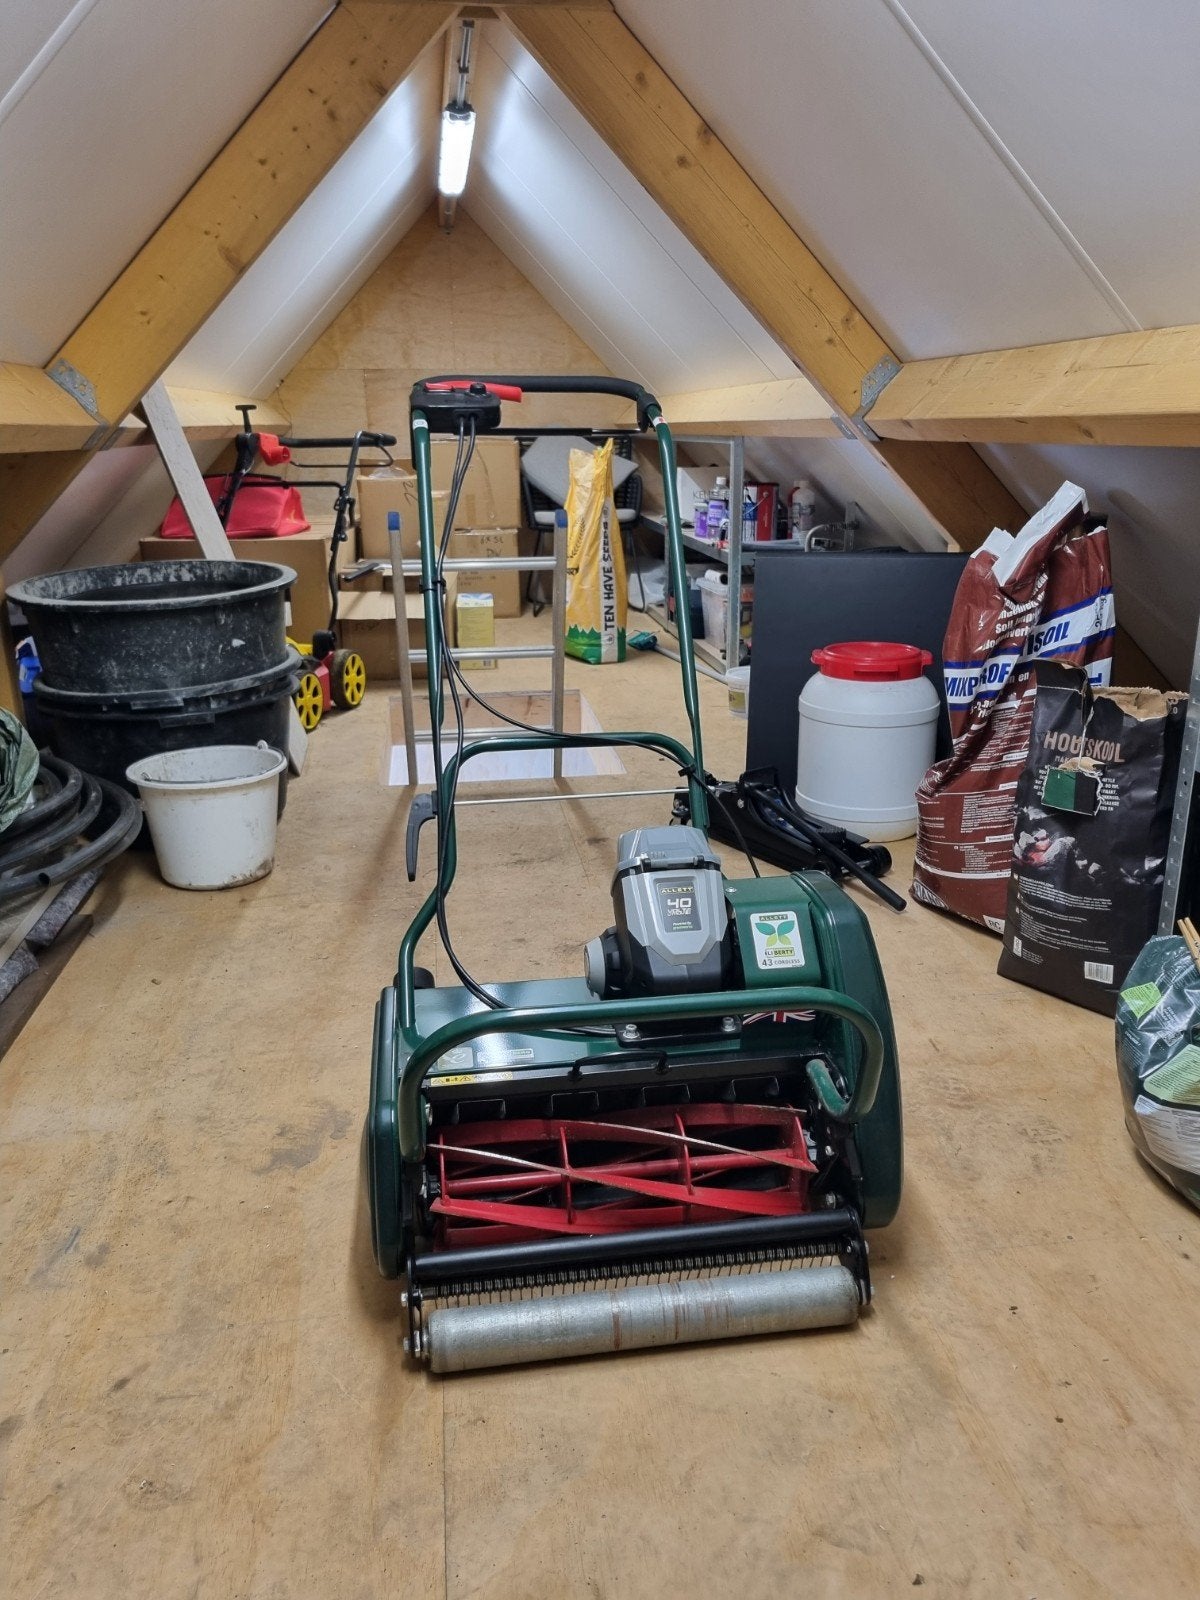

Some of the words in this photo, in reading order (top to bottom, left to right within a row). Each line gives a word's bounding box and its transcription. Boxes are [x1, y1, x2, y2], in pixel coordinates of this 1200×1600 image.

[603, 567, 614, 599] HAVE
[604, 606, 615, 631] TEN
[1026, 620, 1071, 656] ISOIL
[667, 898, 692, 909] 40
